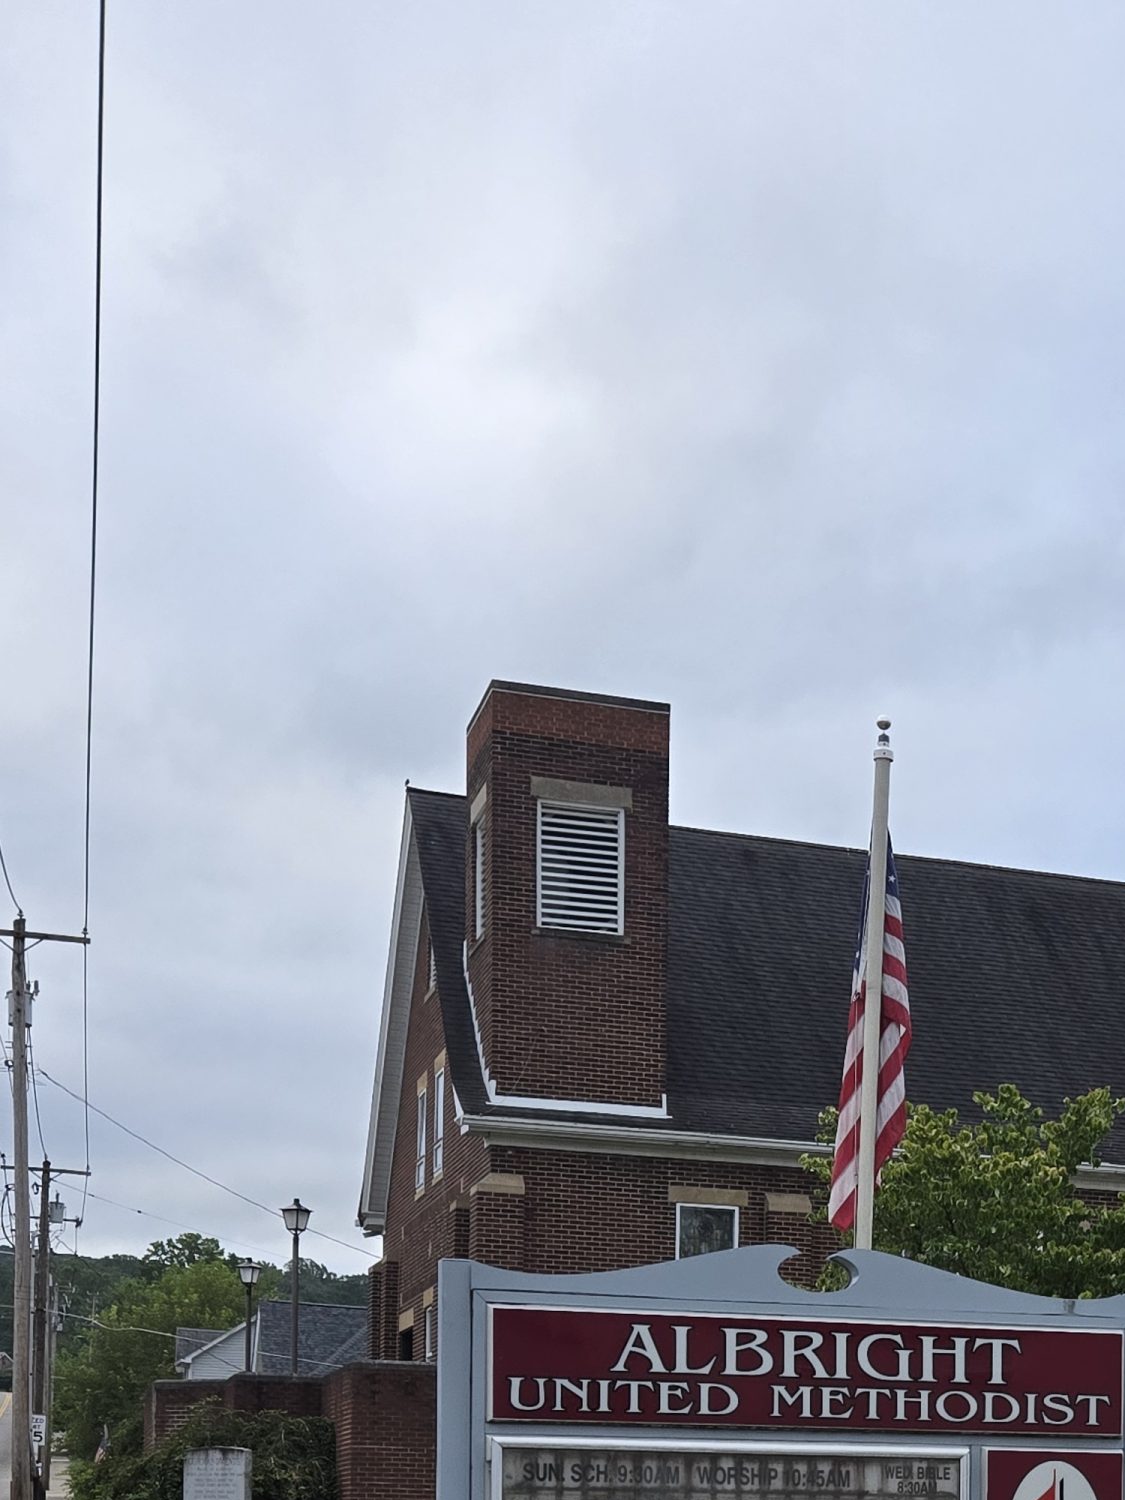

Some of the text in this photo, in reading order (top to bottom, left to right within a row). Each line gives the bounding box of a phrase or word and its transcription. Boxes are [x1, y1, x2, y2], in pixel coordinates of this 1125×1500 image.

[610, 1323, 1021, 1385] ALBRIGHT
[507, 1377, 1110, 1426] UNITED METHODIST
[523, 1463, 565, 1482] SUN.
[571, 1465, 612, 1484] SCH.
[618, 1467, 680, 1485] 9:30AM
[698, 1467, 778, 1486] WORSHIP
[783, 1468, 850, 1488] 10:45AM
[918, 1467, 951, 1481] BIBLE
[897, 1481, 937, 1495] 8:30AM
